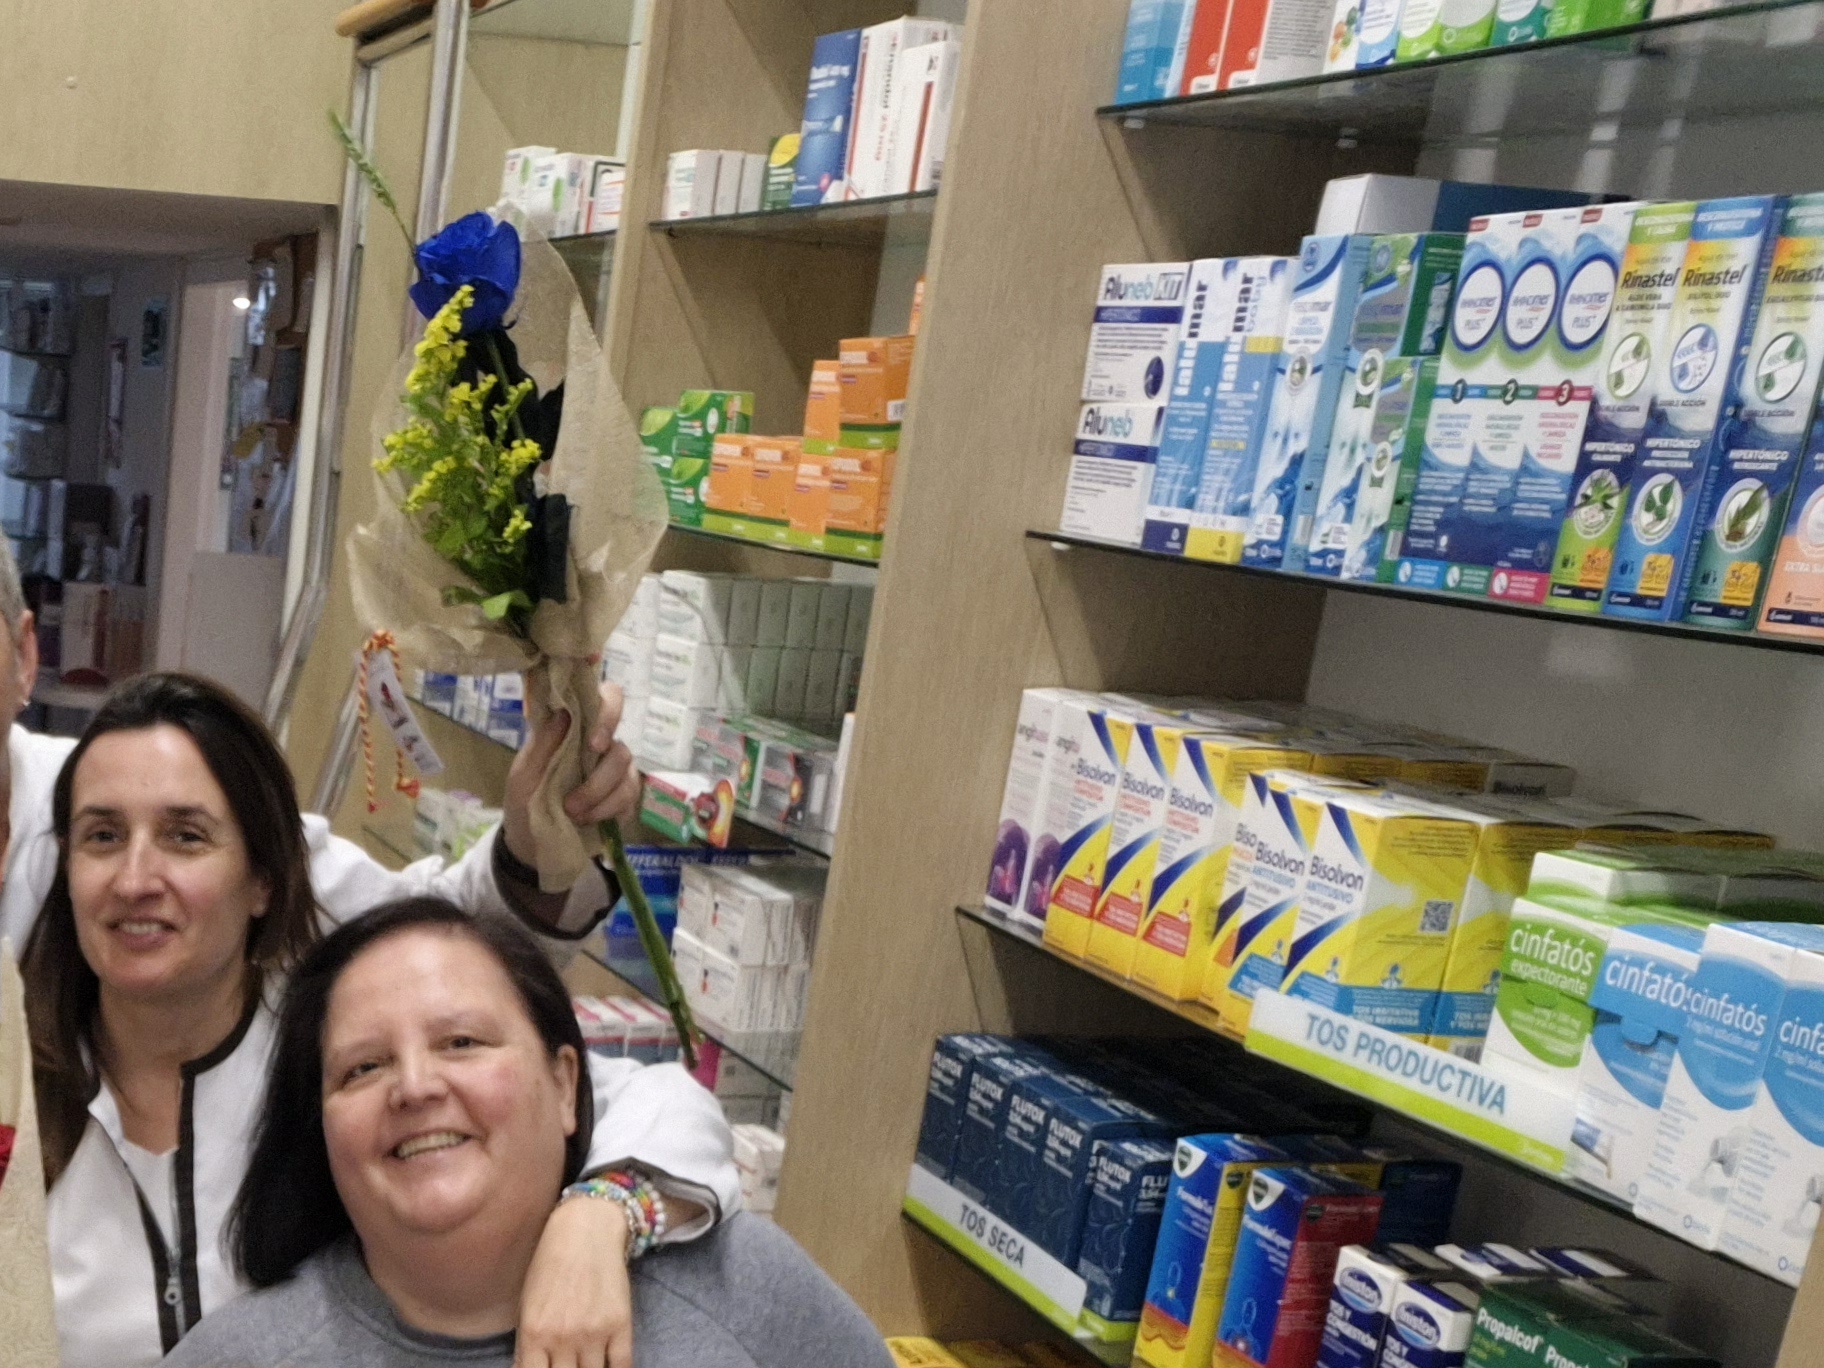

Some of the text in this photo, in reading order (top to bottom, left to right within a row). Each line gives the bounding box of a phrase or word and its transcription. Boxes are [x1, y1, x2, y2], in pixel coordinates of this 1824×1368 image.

[1103, 272, 1154, 301] Aluneb
[1620, 267, 1681, 289] Rinastel
[1682, 264, 1748, 287] Rinastel
[1772, 264, 1824, 285] Rinast
[1558, 383, 1568, 402] 3
[1082, 406, 1134, 438] Aluneb
[1076, 758, 1117, 786] Bisolvon
[1123, 772, 1165, 800] Bisolvon
[1170, 787, 1214, 818] Bisolvon
[1234, 823, 1258, 848] Biso
[1255, 841, 1306, 876] Bisolvon
[1308, 856, 1364, 892] Bisolvon
[1510, 924, 1596, 978] cinfatós
[1511, 959, 1588, 996] expectorante
[1605, 955, 1691, 1012] cinfató
[1689, 980, 1768, 1039] cinfatós
[1779, 1017, 1824, 1056] cinfa
[932, 1052, 964, 1079] FLUTOX
[1305, 1012, 1507, 1116] TOS PRODUCTIVA
[971, 1072, 1004, 1101] FLUTOX
[1010, 1095, 1047, 1125] FLUTOX
[1049, 1117, 1084, 1149] FLUTOX
[1099, 1156, 1133, 1184] FLUTOX
[1142, 1174, 1169, 1189] FLU
[959, 1203, 1027, 1268] TOS SECA
[1477, 1306, 1541, 1355] Propalcof
